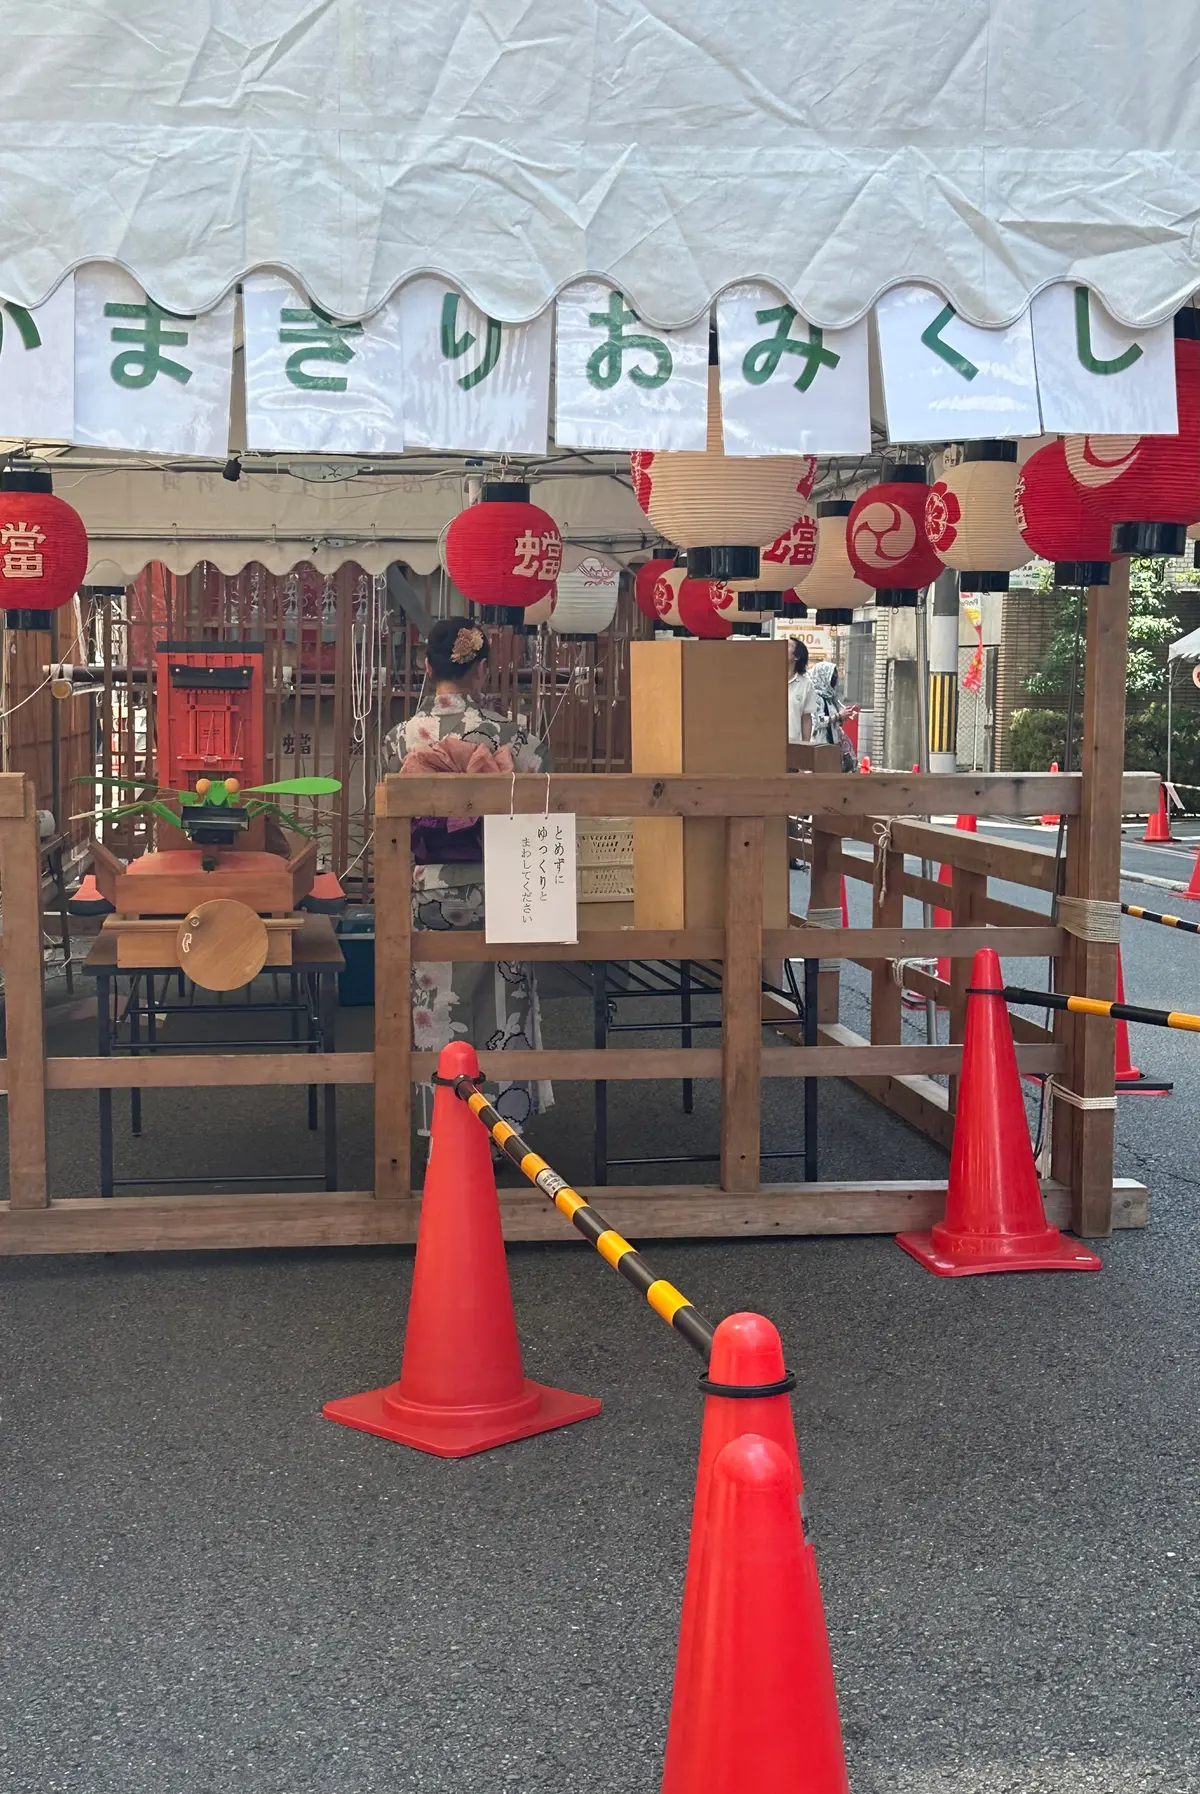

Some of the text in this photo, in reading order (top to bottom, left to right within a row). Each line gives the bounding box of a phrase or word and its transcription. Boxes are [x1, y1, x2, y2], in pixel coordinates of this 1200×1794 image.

[521, 837, 533, 923] まわしてください
[537, 826, 548, 902] ゆっくりと
[553, 825, 565, 885] とめずに
